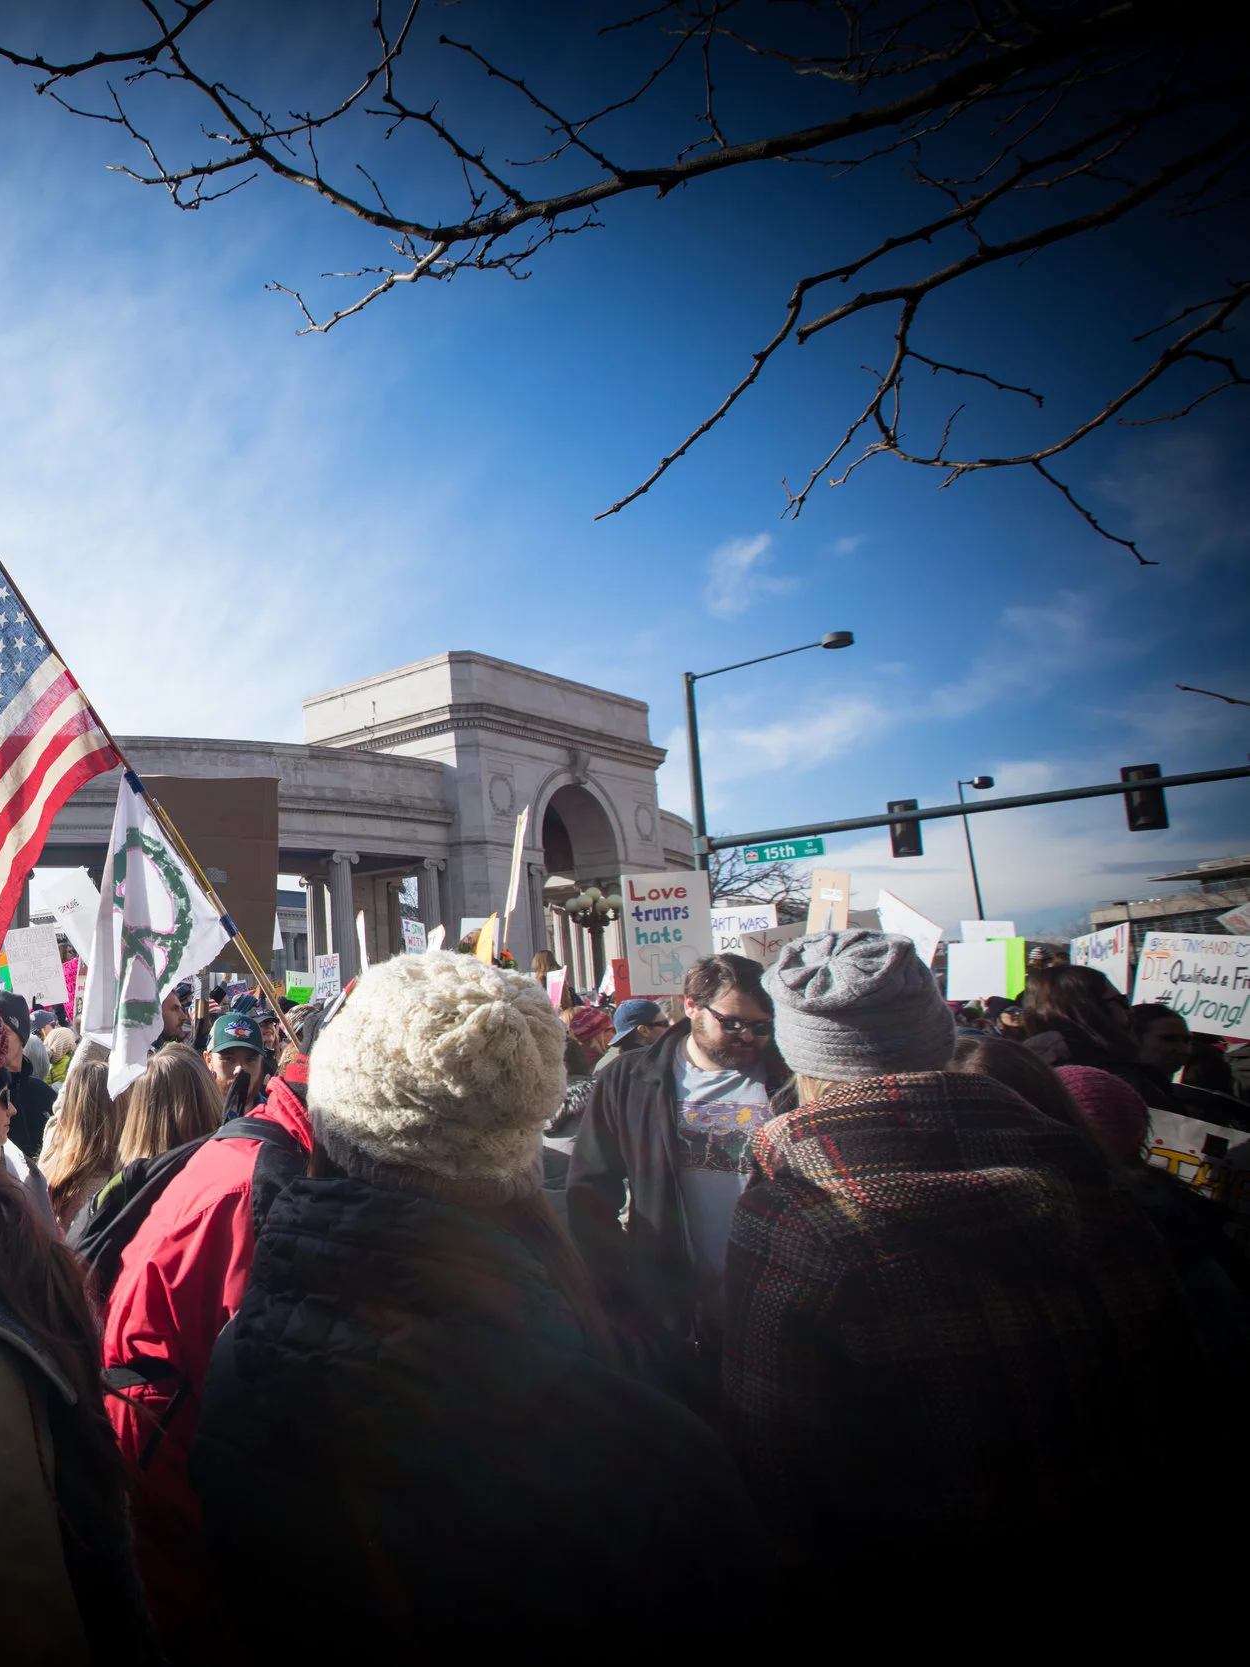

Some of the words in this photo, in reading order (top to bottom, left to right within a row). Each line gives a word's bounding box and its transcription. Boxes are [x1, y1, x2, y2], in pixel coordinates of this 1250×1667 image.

[763, 845, 796, 860] 15th
[629, 880, 688, 902] Love
[631, 905, 689, 922] trumps
[635, 926, 682, 945] hate
[319, 955, 338, 968] LOVE
[322, 966, 335, 978] NOT
[318, 980, 339, 992] HATE
